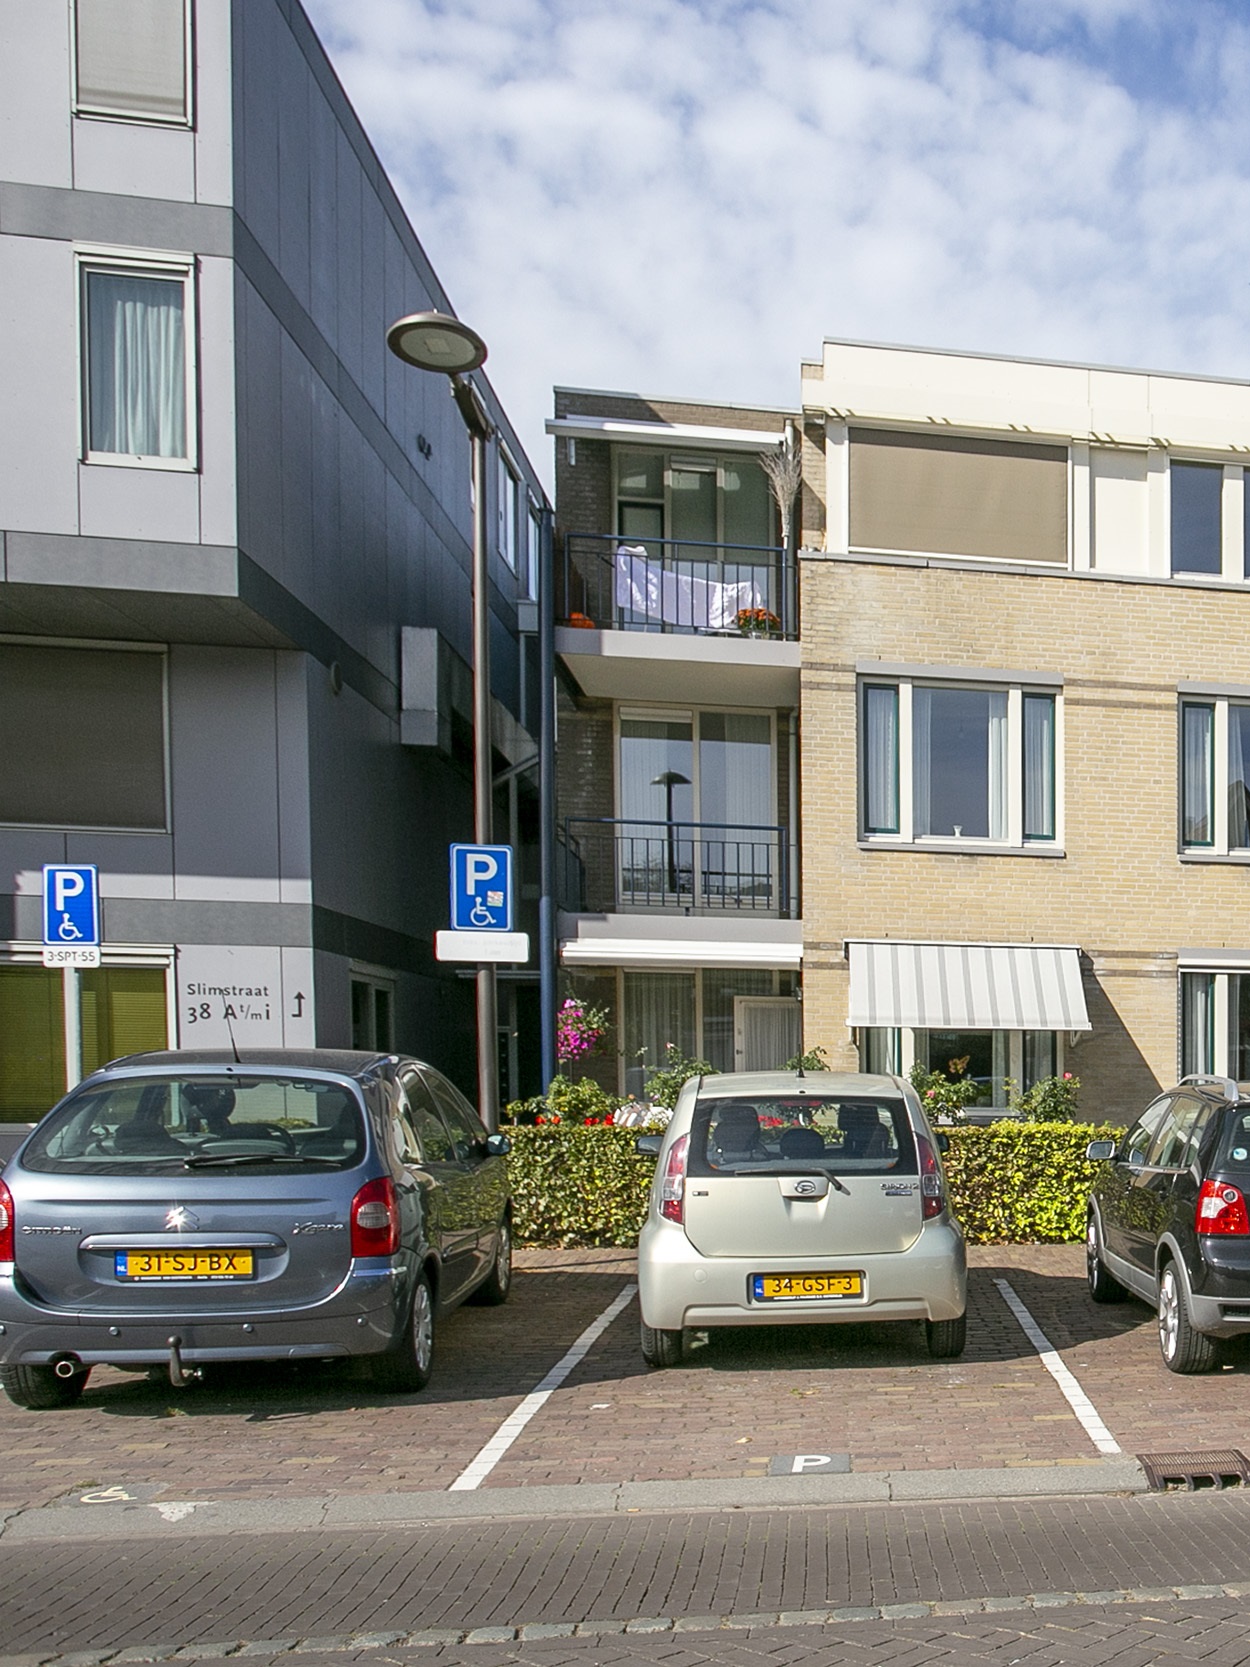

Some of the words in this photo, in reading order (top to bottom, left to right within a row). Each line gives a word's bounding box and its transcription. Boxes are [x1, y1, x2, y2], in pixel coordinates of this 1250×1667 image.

[466, 853, 498, 895] P
[55, 871, 84, 911] P
[47, 951, 96, 962] 3-SPT-55
[187, 983, 269, 996] Slimstraat
[187, 1002, 212, 1024] 38
[772, 1276, 852, 1293] 34-GSF-3
[792, 1454, 832, 1473] P
